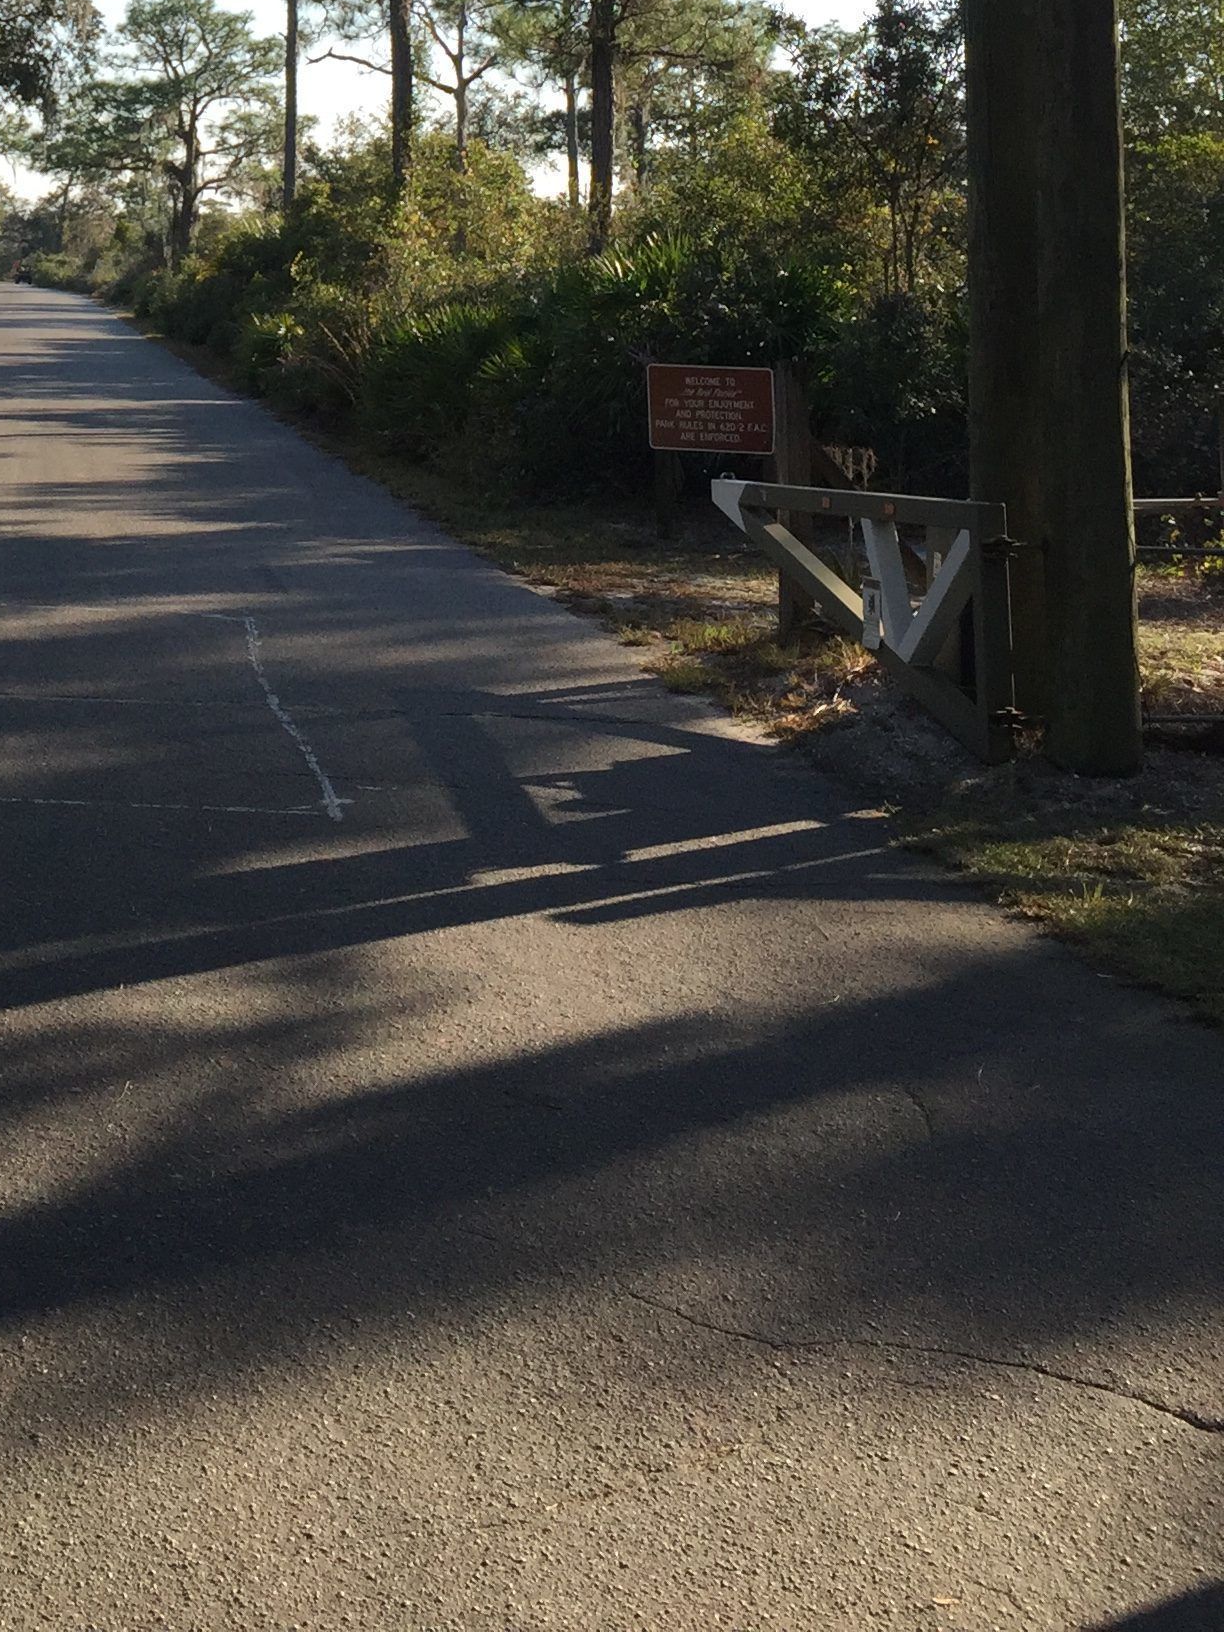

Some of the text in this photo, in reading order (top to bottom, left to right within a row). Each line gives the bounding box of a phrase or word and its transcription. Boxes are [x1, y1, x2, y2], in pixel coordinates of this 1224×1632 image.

[685, 376, 736, 386] WELCOME TO
[664, 398, 755, 410] FOR YOUR ENJOYMENT
[676, 409, 692, 419] AND
[656, 419, 675, 429] PARK
[679, 420, 704, 430] RULES
[707, 422, 716, 430] IN
[680, 431, 695, 441] ARE
